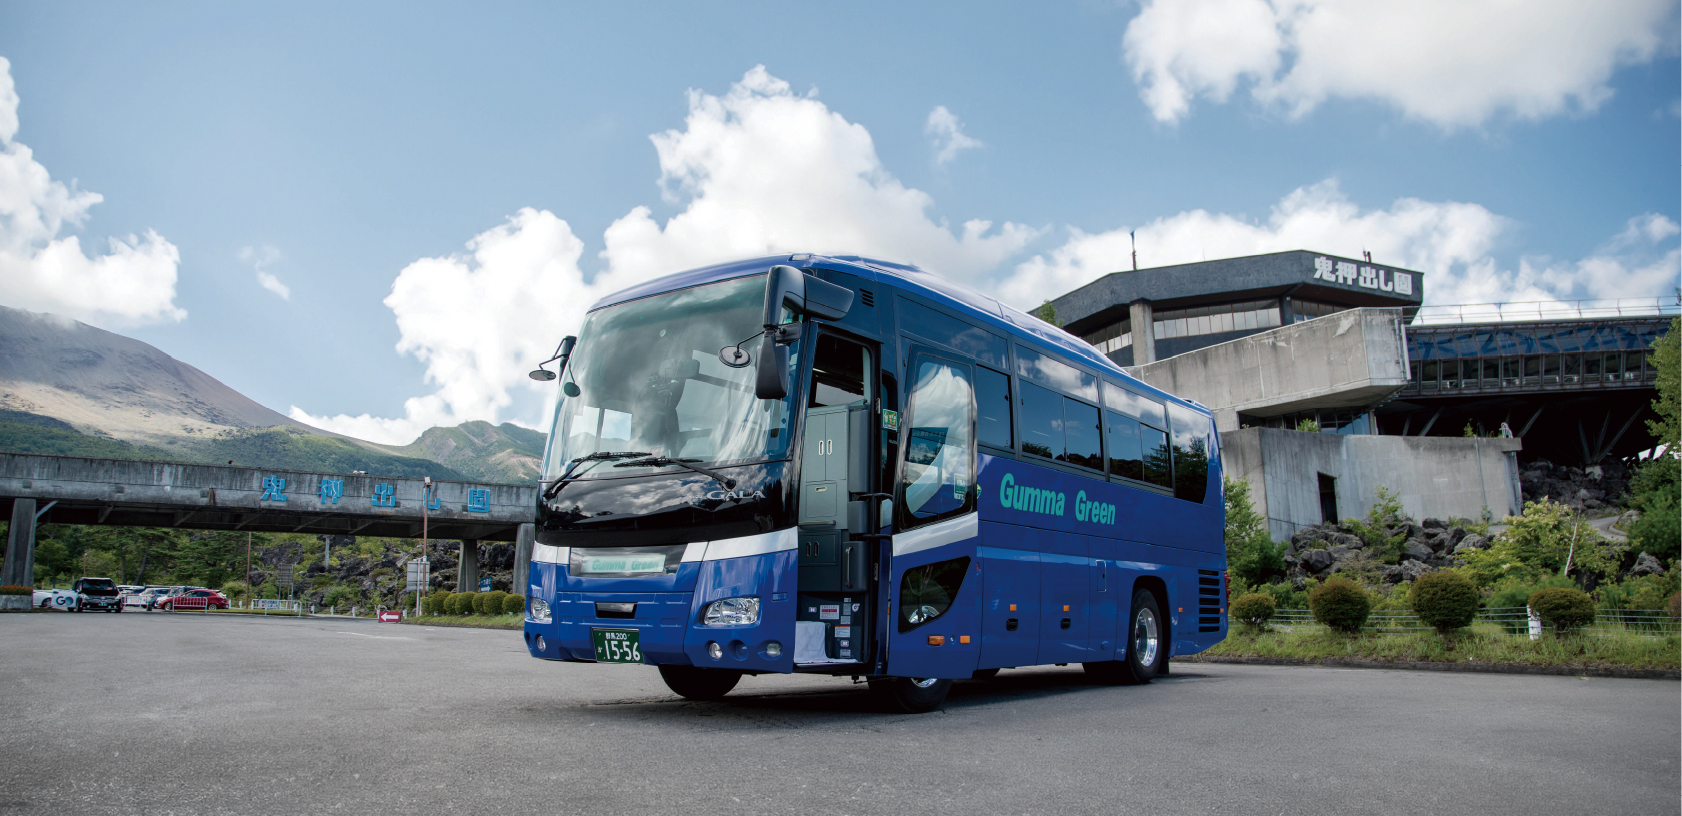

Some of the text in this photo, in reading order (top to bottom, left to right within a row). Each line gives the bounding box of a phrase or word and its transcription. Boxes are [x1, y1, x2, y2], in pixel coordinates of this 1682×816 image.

[1313, 256, 1412, 295] 鬼押出し園
[706, 490, 767, 500] GALA
[1000, 473, 1065, 516] Gumma
[1075, 490, 1116, 525] Green
[592, 560, 660, 571] Gumma Green
[604, 640, 641, 661] 15-56
